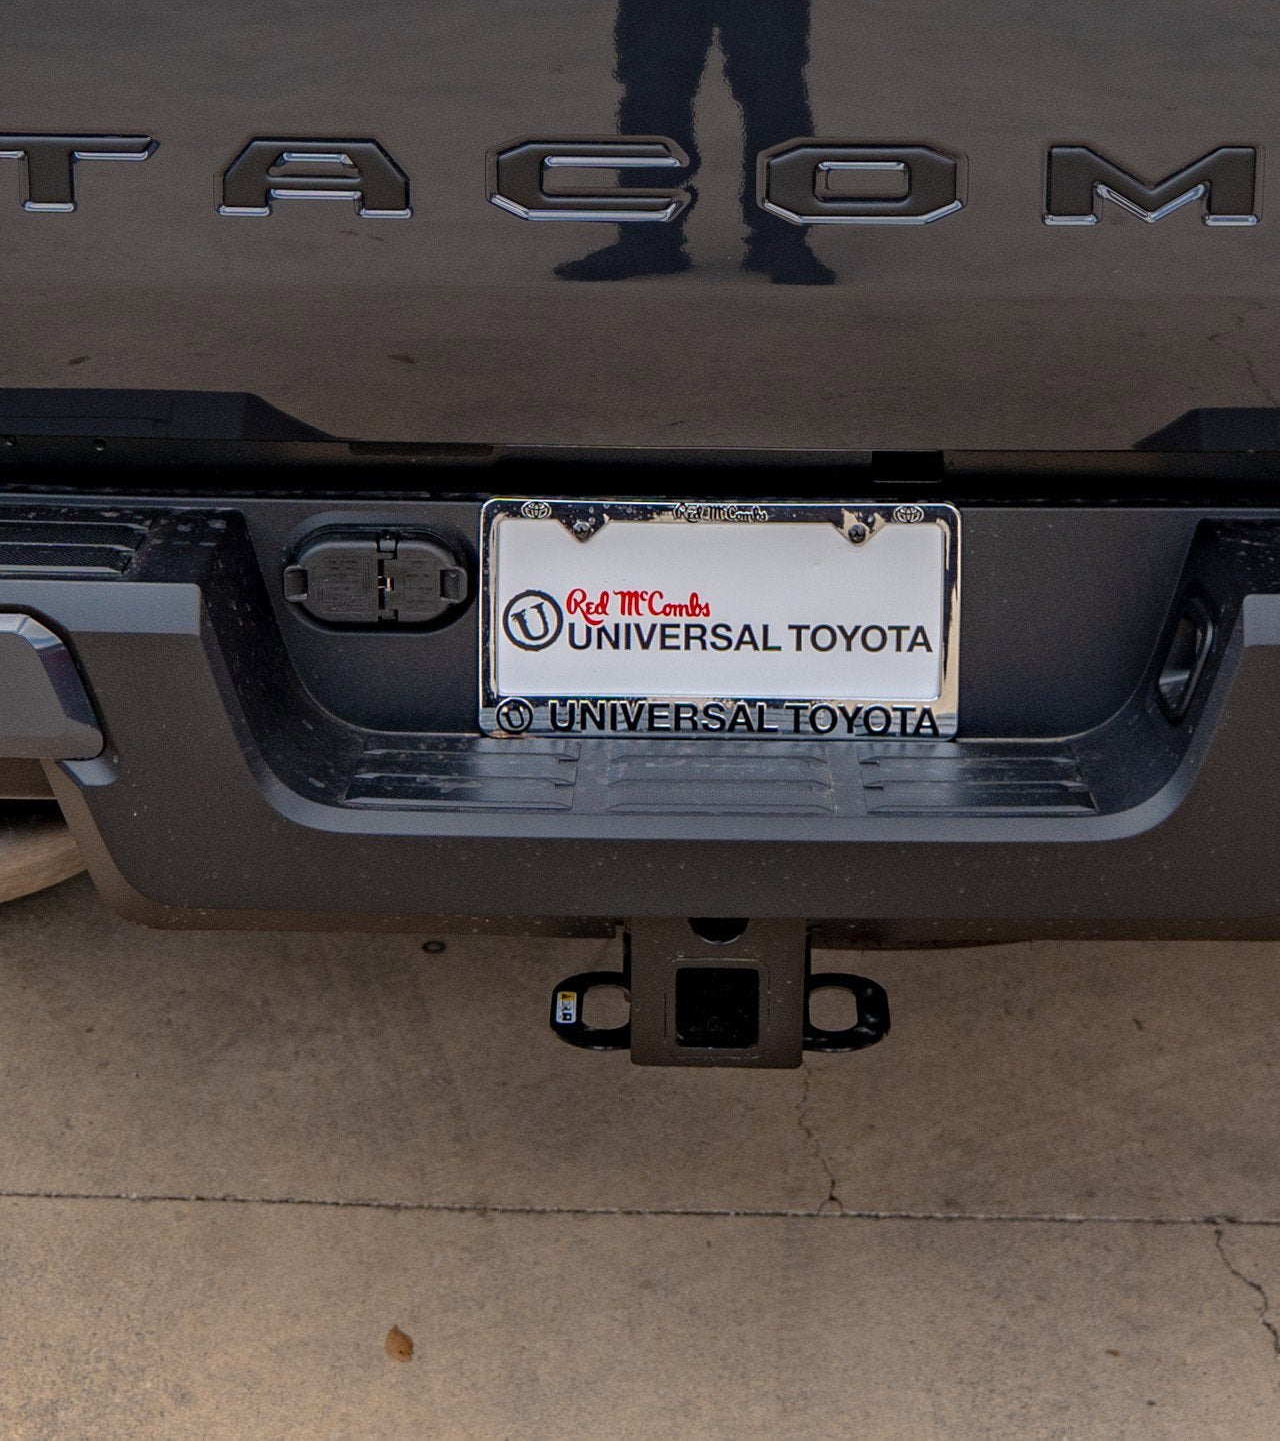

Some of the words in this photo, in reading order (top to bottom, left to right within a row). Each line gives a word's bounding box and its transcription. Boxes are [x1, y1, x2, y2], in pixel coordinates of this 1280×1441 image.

[565, 588, 609, 626] Red
[613, 590, 711, 619] McCombs
[567, 621, 782, 653] UNIVERSAL
[787, 623, 934, 654] TOYOTA
[548, 698, 778, 734] UNIVERSAL
[784, 700, 940, 736] TOYOTA
